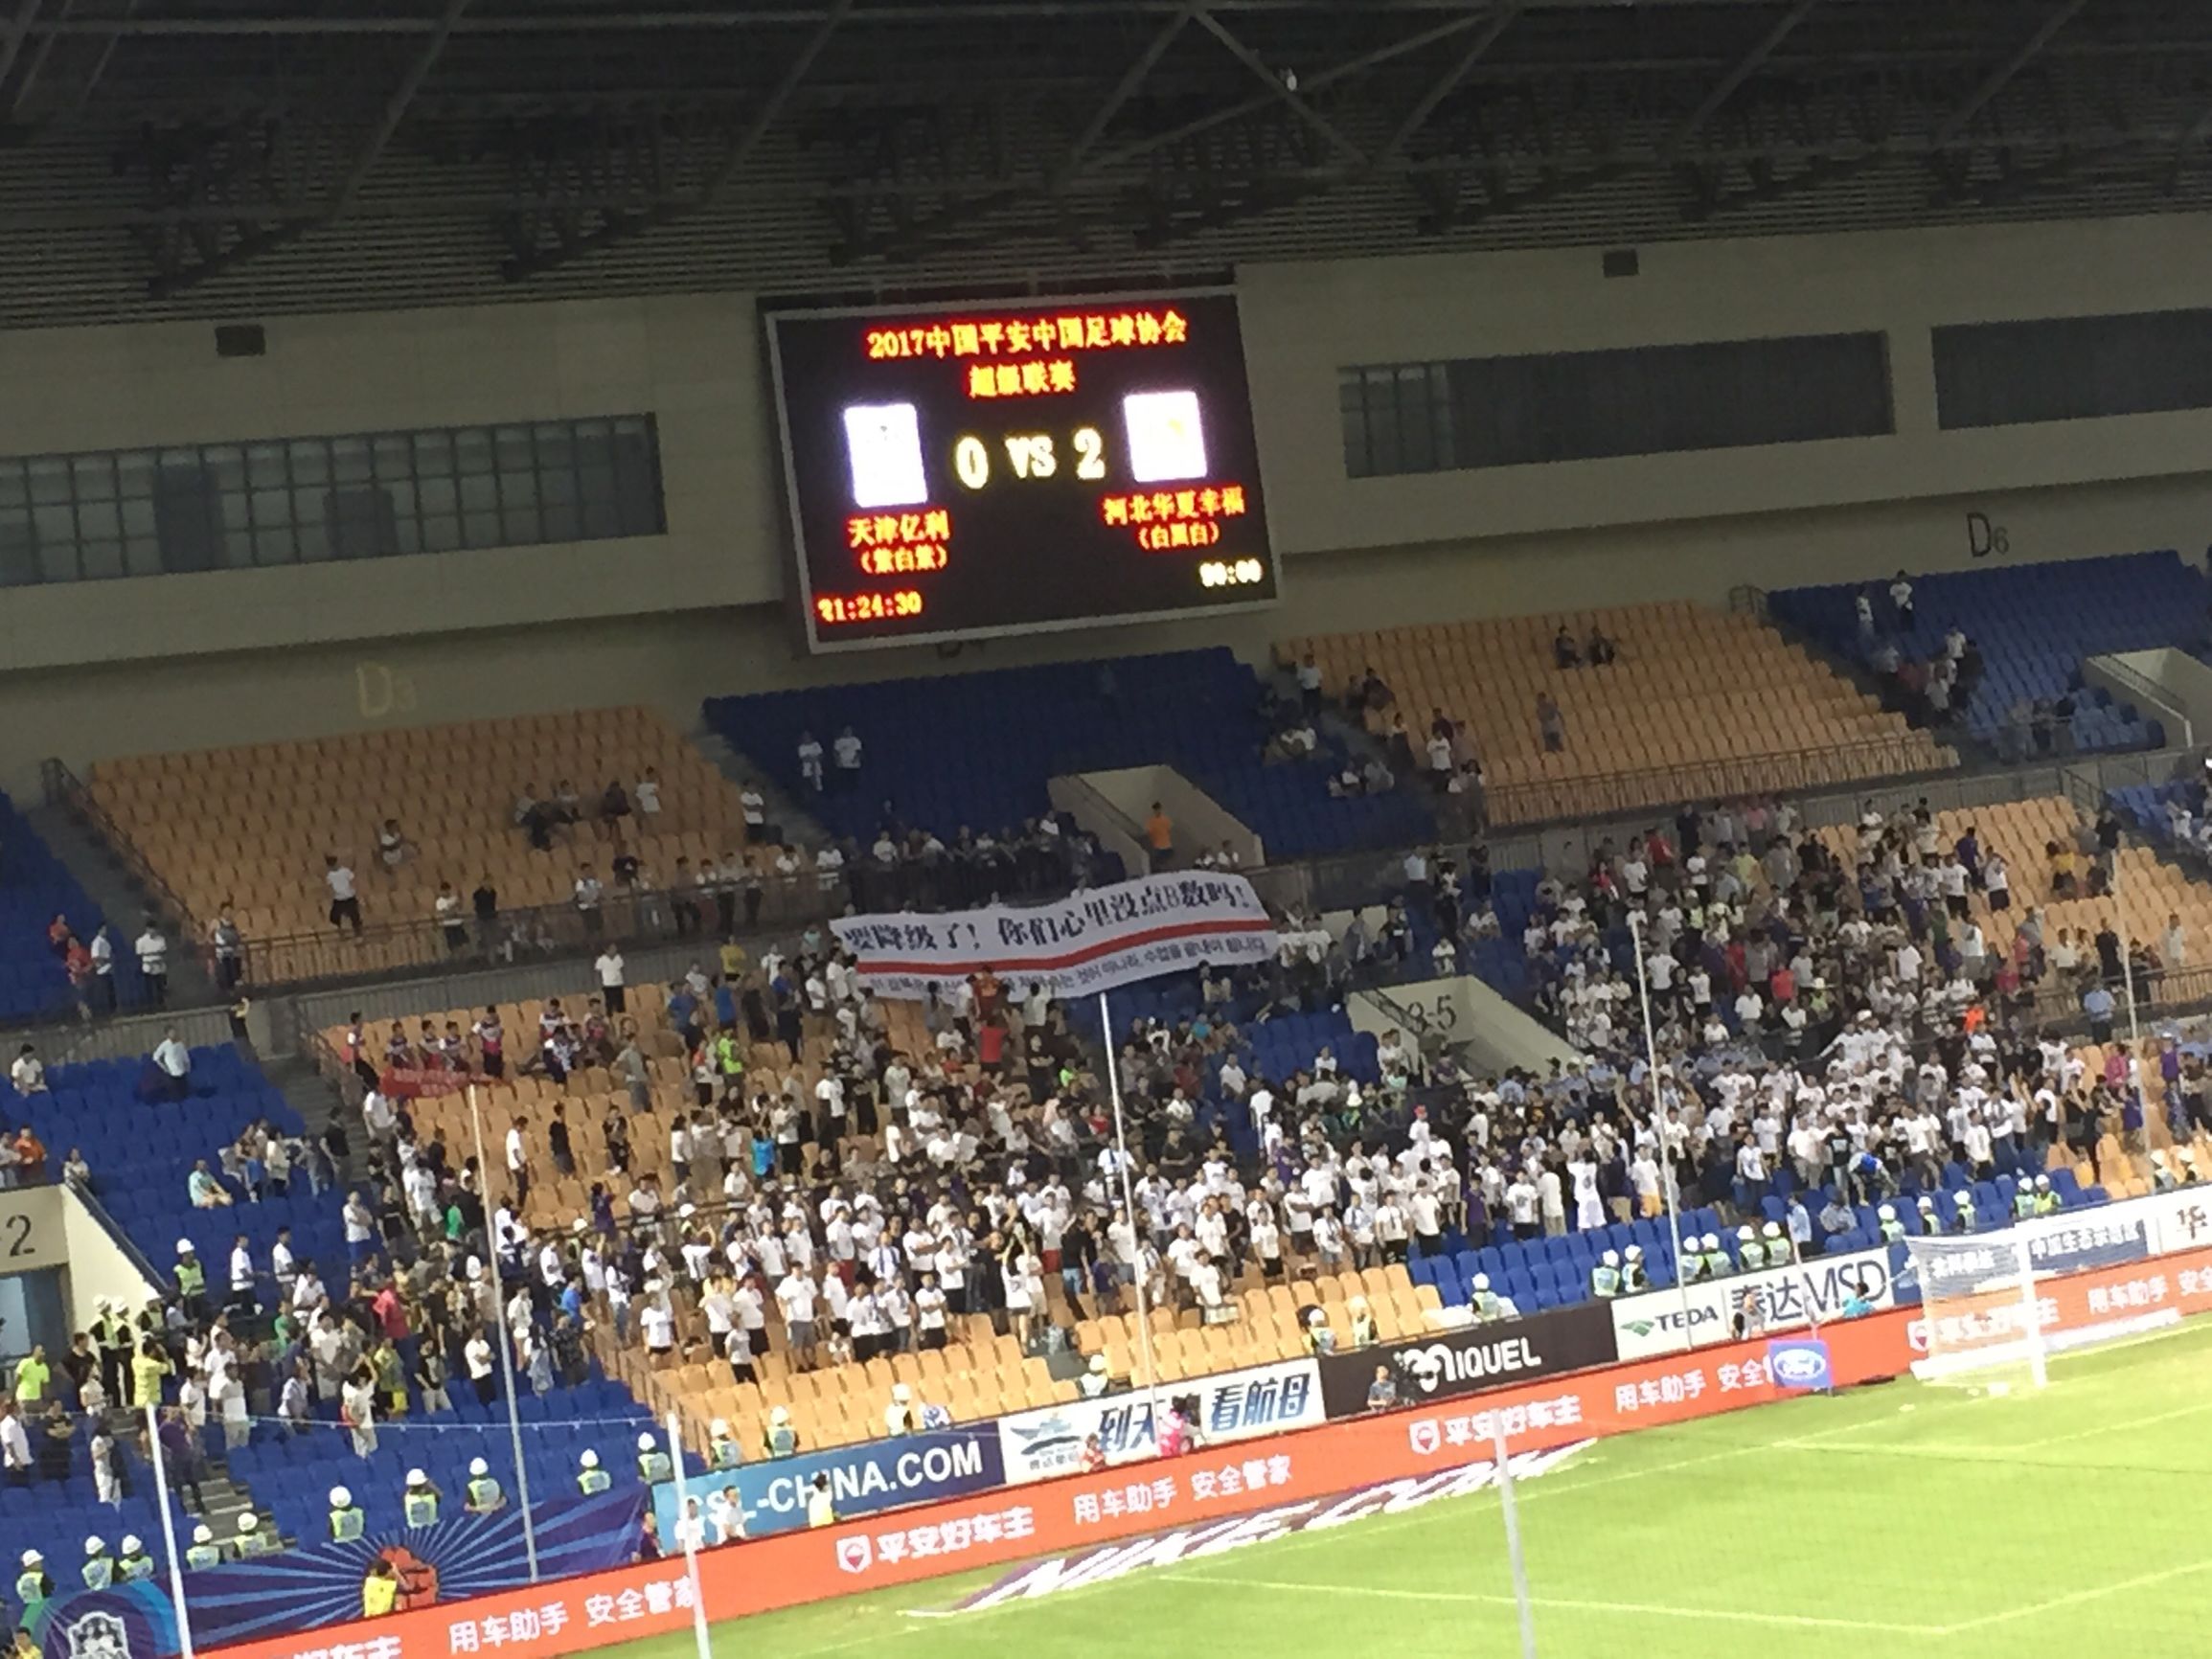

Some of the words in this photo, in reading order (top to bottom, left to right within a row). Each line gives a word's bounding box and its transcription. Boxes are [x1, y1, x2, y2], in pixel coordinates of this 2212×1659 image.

[868, 311, 1188, 358] 2017中国平安中国足球协会
[969, 360, 1076, 398] 超级联赛
[956, 436, 989, 489] 0
[1004, 435, 1056, 479] VS
[1073, 427, 1106, 480] 2
[847, 509, 950, 549] 天津亿利
[1103, 486, 1245, 527] 河北华夏幸福
[1966, 511, 2010, 558] D6
[1654, 1305, 1720, 1331] TEDA
[1614, 1368, 1706, 1413] 用车助手
[1717, 1357, 1773, 1393] 安全
[876, 1505, 1036, 1565] 平安好车主
[1072, 1475, 1177, 1525] 用车助手
[1190, 1453, 1293, 1502] 安全管家
[447, 1600, 570, 1655] 用车助手
